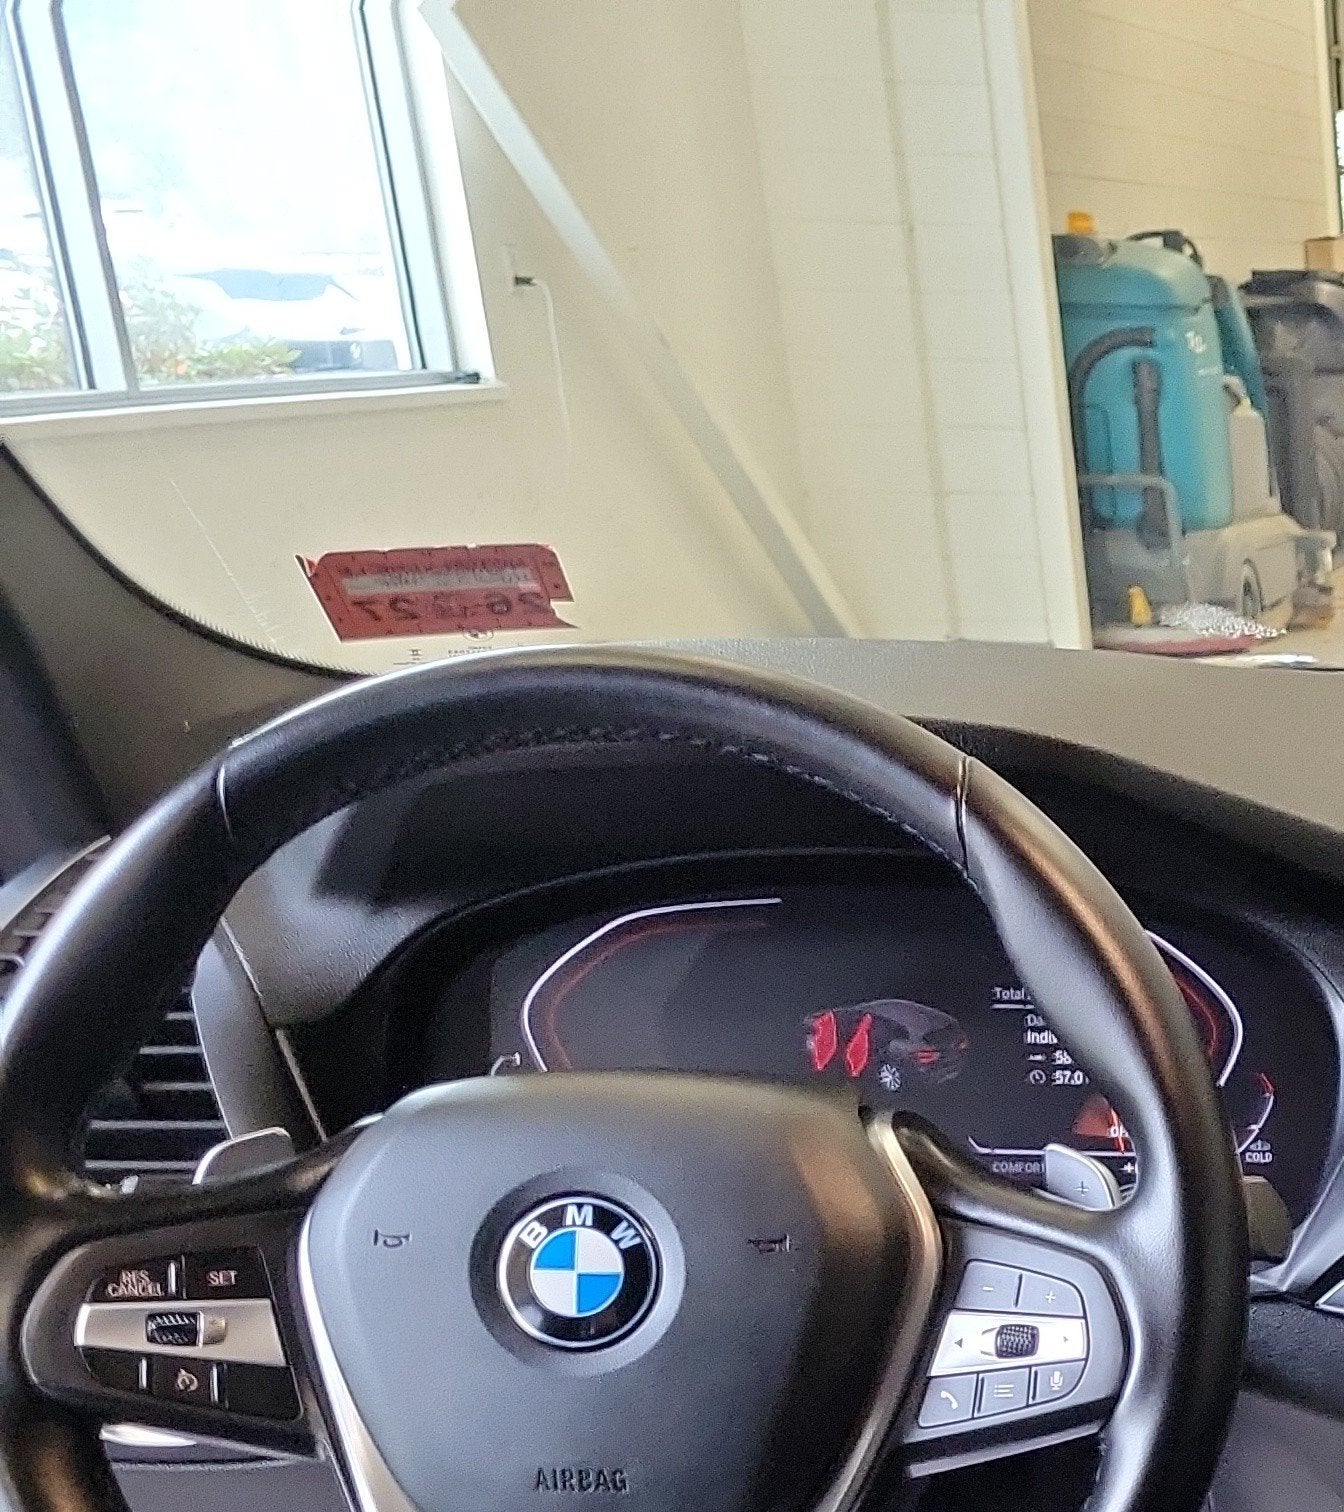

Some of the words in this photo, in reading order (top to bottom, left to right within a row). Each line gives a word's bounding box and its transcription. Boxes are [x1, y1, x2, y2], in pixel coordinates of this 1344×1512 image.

[992, 986, 1025, 1001] Total
[1245, 1151, 1273, 1164] COLD
[519, 1203, 642, 1250] BMW
[208, 1269, 238, 1286] SET
[532, 1466, 630, 1493] AIRBAG
